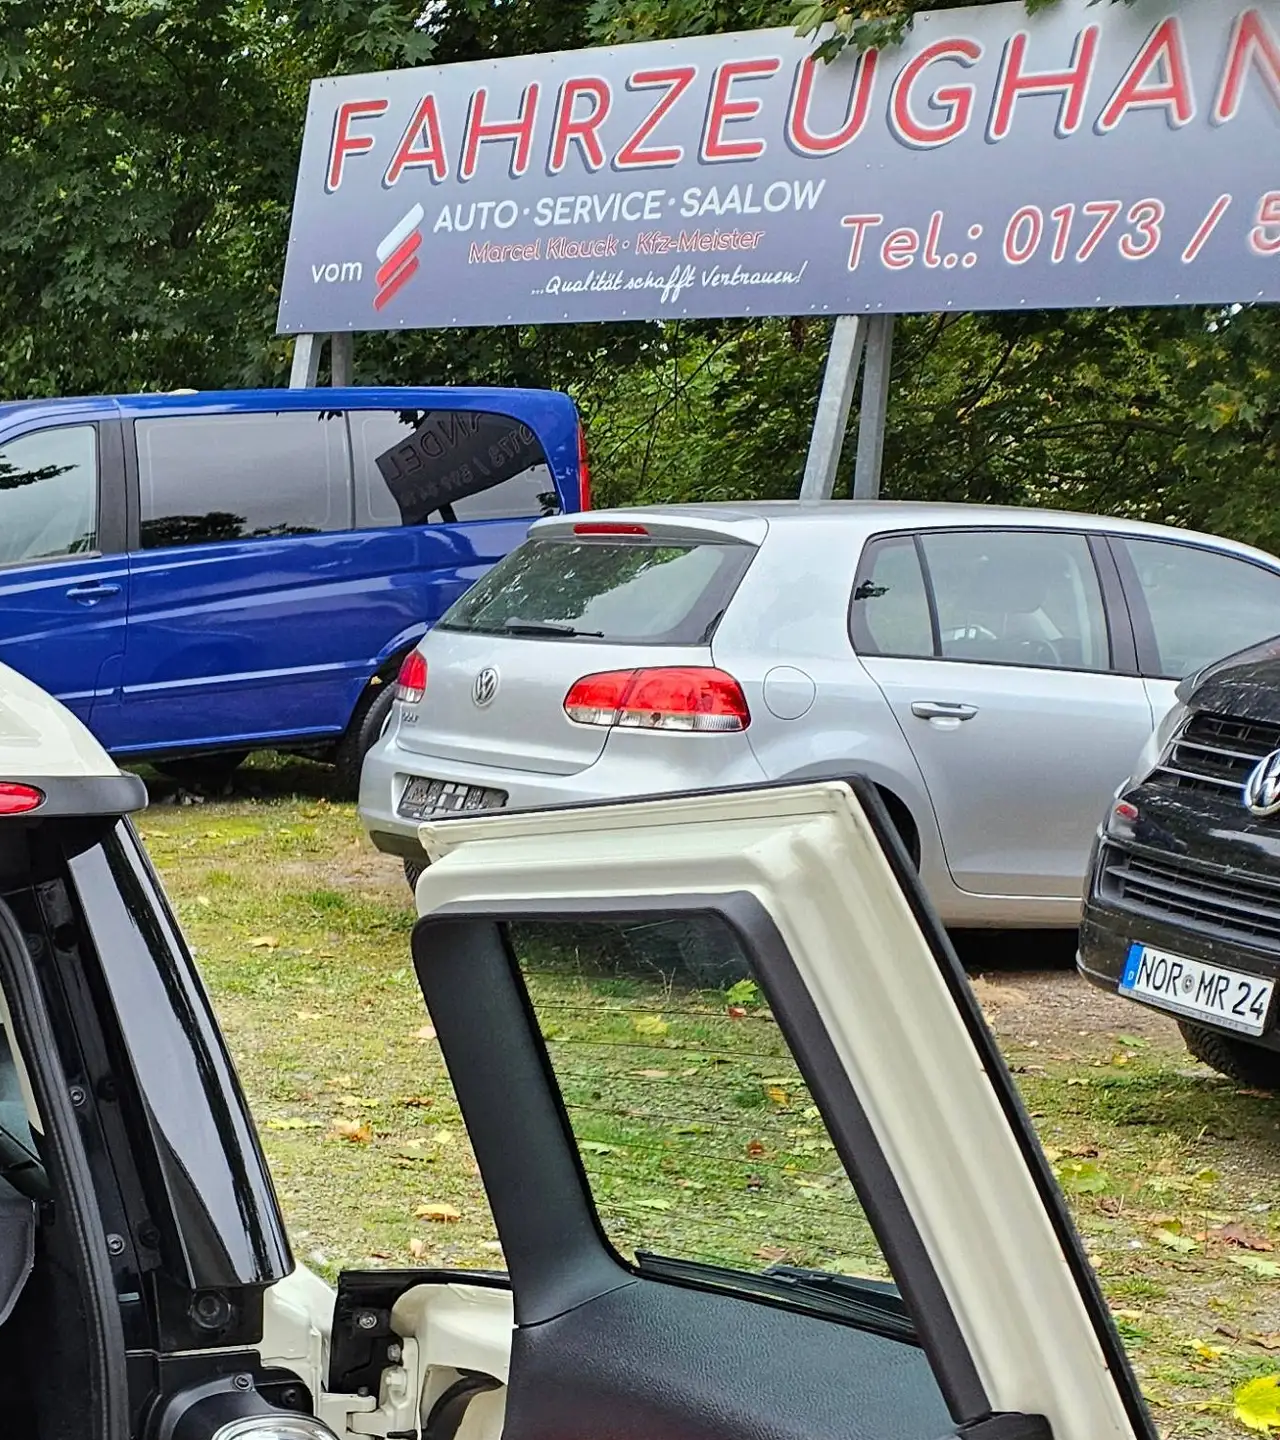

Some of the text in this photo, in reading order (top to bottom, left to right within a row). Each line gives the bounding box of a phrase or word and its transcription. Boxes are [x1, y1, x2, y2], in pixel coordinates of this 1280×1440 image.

[433, 178, 827, 233] AUTO SERVICE SAALOW
[468, 228, 766, 264] Marcel Klauck Kfz-Meister
[841, 211, 983, 272] Tel.:
[1003, 198, 1166, 266] 0173
[1180, 193, 1232, 265] /
[311, 261, 362, 284] vom
[622, 264, 697, 304] schafft
[700, 260, 809, 288] Vertrauen!
[1137, 952, 1184, 997] NOR
[1195, 970, 1231, 1011] MR
[1231, 981, 1269, 1021] 24
